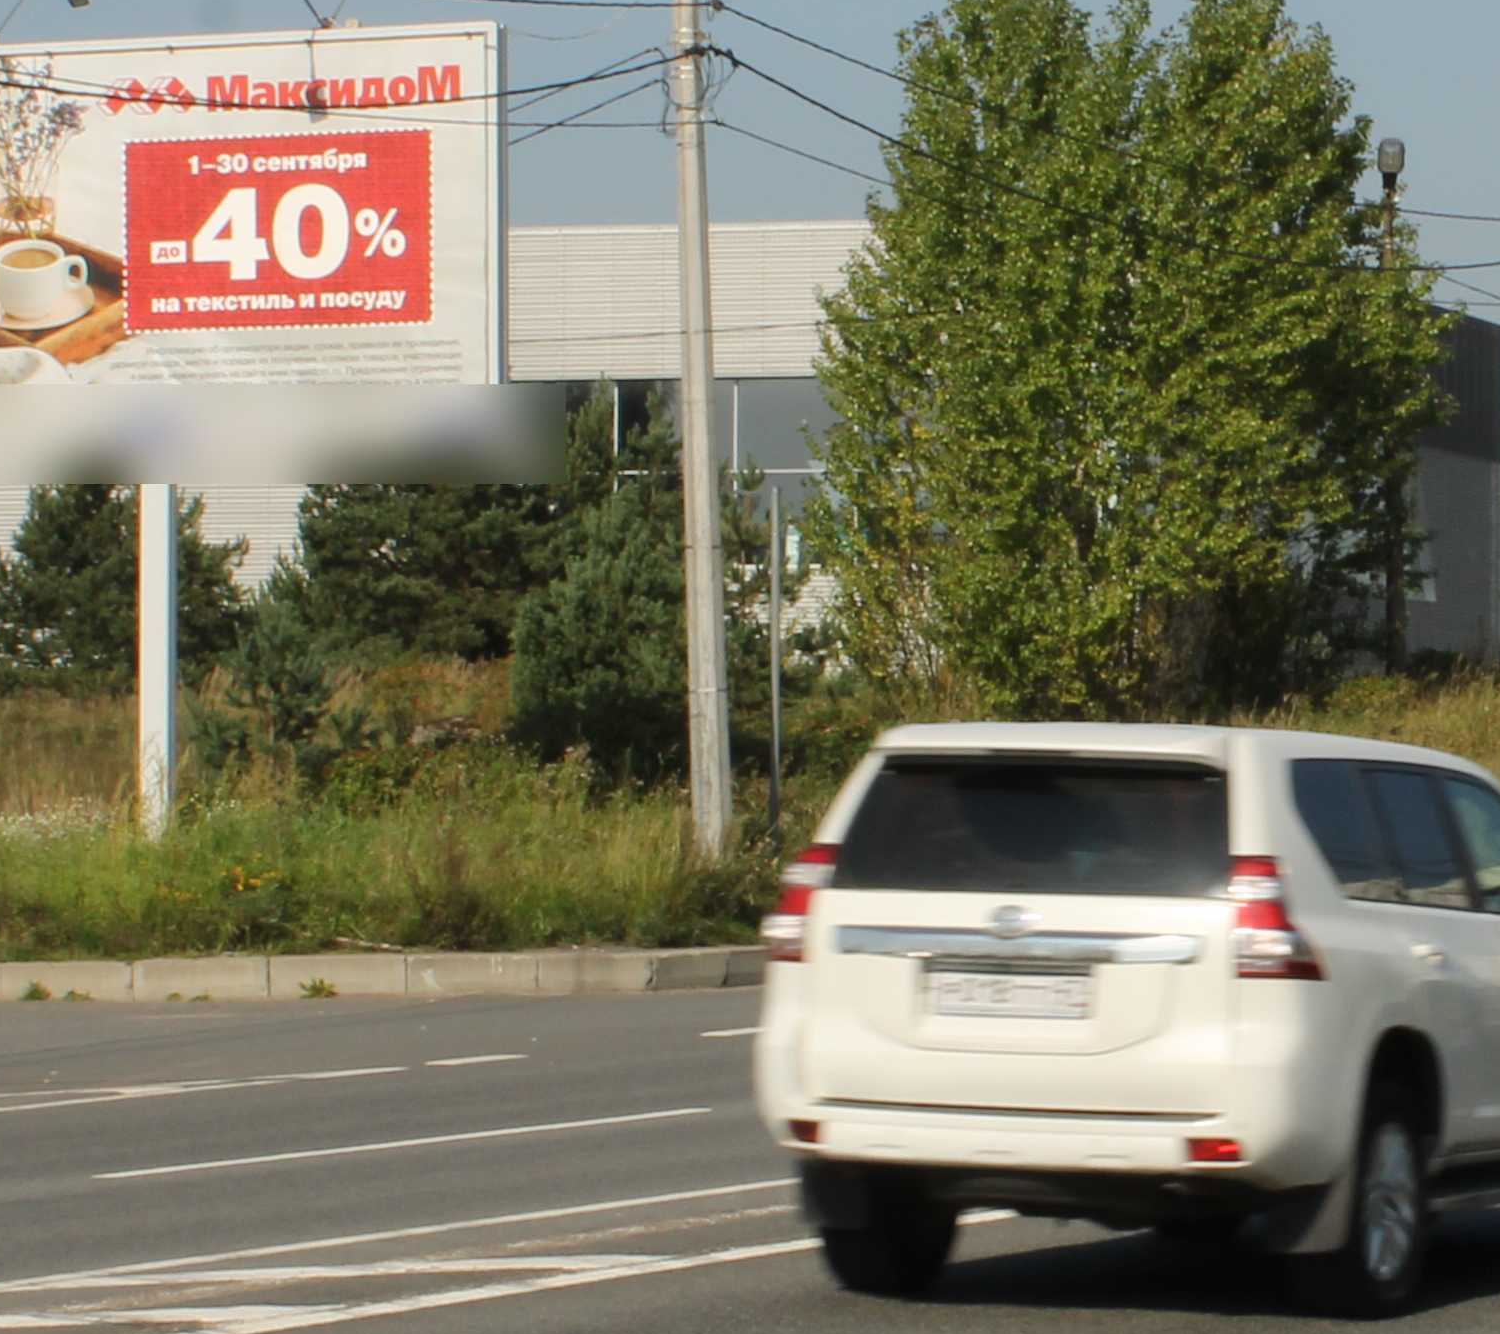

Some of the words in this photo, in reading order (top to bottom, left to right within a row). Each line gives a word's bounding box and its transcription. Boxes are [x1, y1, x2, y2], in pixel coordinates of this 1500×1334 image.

[252, 148, 367, 173] сентября
[156, 247, 181, 261] до
[151, 297, 181, 314] на
[185, 293, 296, 312] текстиль
[300, 293, 315, 308] и
[320, 290, 406, 312] посуду
